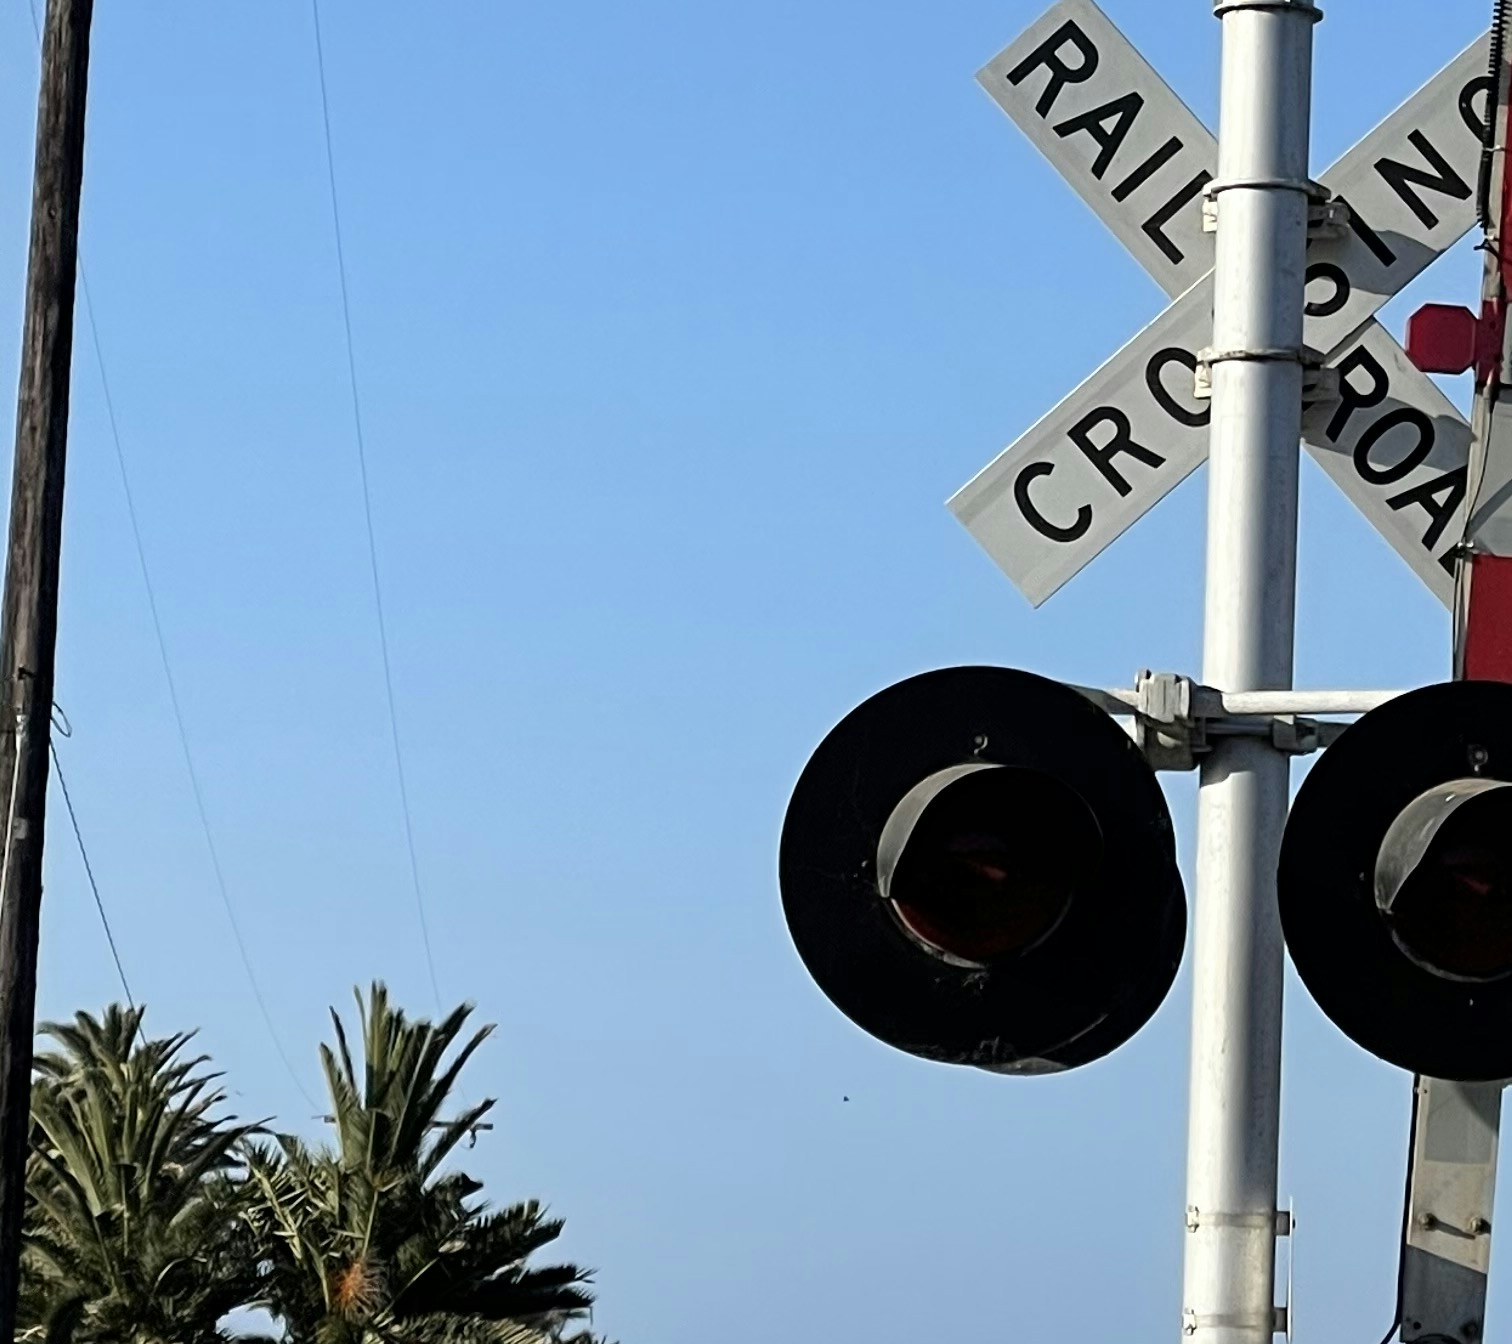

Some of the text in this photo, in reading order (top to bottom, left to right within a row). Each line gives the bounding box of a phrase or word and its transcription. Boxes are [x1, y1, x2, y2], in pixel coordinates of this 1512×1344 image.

[1006, 19, 1468, 578] RAIL ROA
[1013, 76, 1495, 543] CROIN
